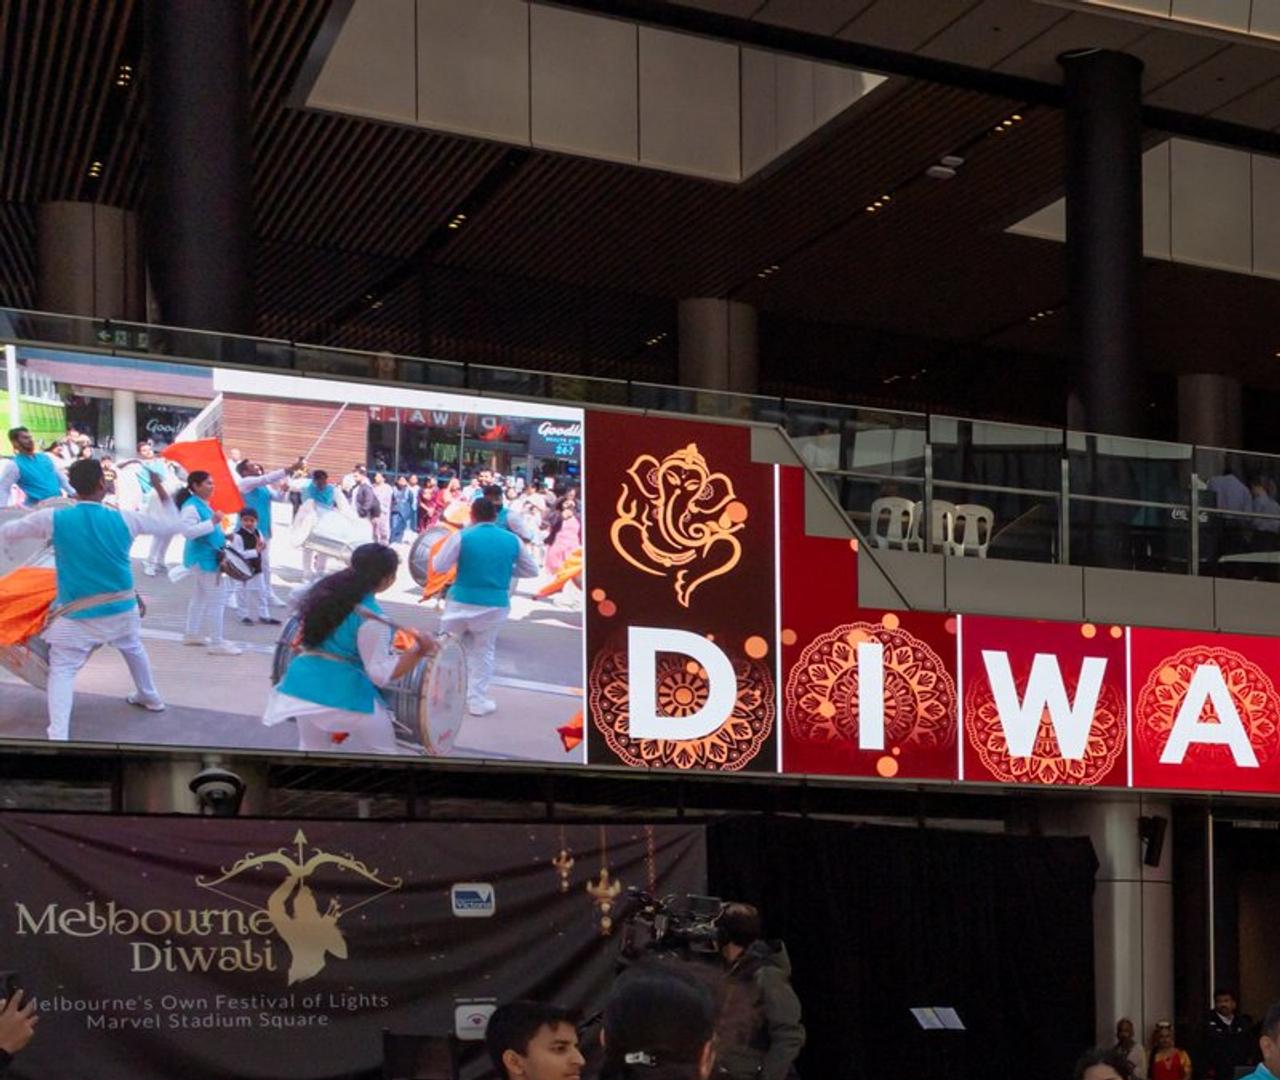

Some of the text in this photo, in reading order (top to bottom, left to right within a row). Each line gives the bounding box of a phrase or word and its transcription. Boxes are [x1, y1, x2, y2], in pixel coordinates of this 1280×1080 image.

[15, 901, 276, 937] Melbourne
[130, 940, 277, 973] Diwali
[161, 995, 207, 1010] Own
[215, 993, 294, 1010] Festival
[302, 993, 321, 1009] of
[330, 992, 389, 1011] Lights
[87, 1012, 328, 1030] Marvel Stadium Square
